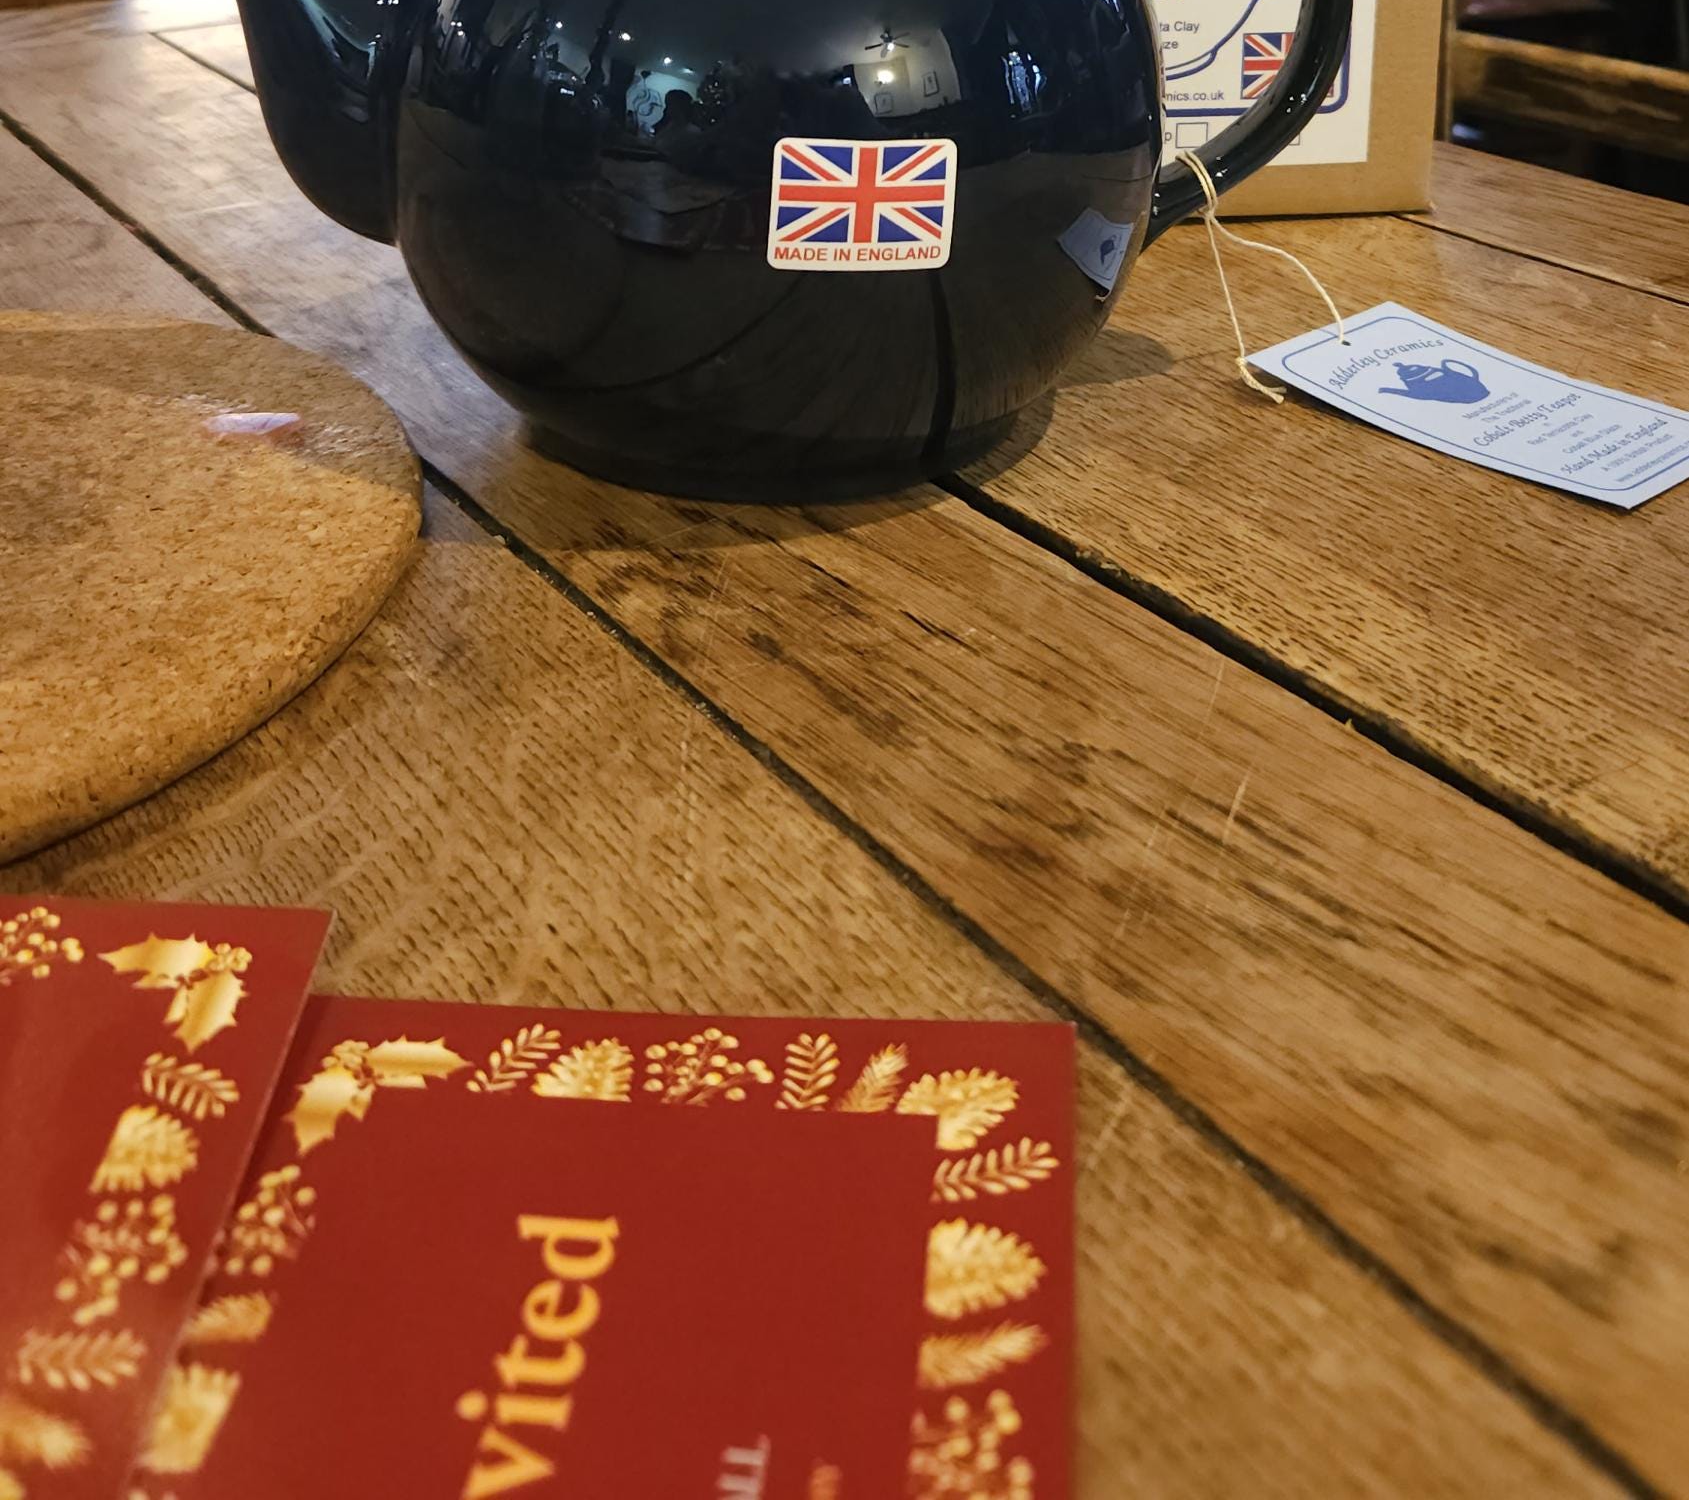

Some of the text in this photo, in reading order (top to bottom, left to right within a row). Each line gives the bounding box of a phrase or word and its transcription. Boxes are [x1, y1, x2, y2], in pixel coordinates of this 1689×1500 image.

[1173, 20, 1200, 34] Clay
[774, 246, 942, 261] MADE IN ENGLAND
[1328, 339, 1445, 390] Adderley Ceramics
[1473, 425, 1515, 446] Cobalt
[1508, 412, 1548, 428] Betty
[1537, 393, 1581, 413] Teapot
